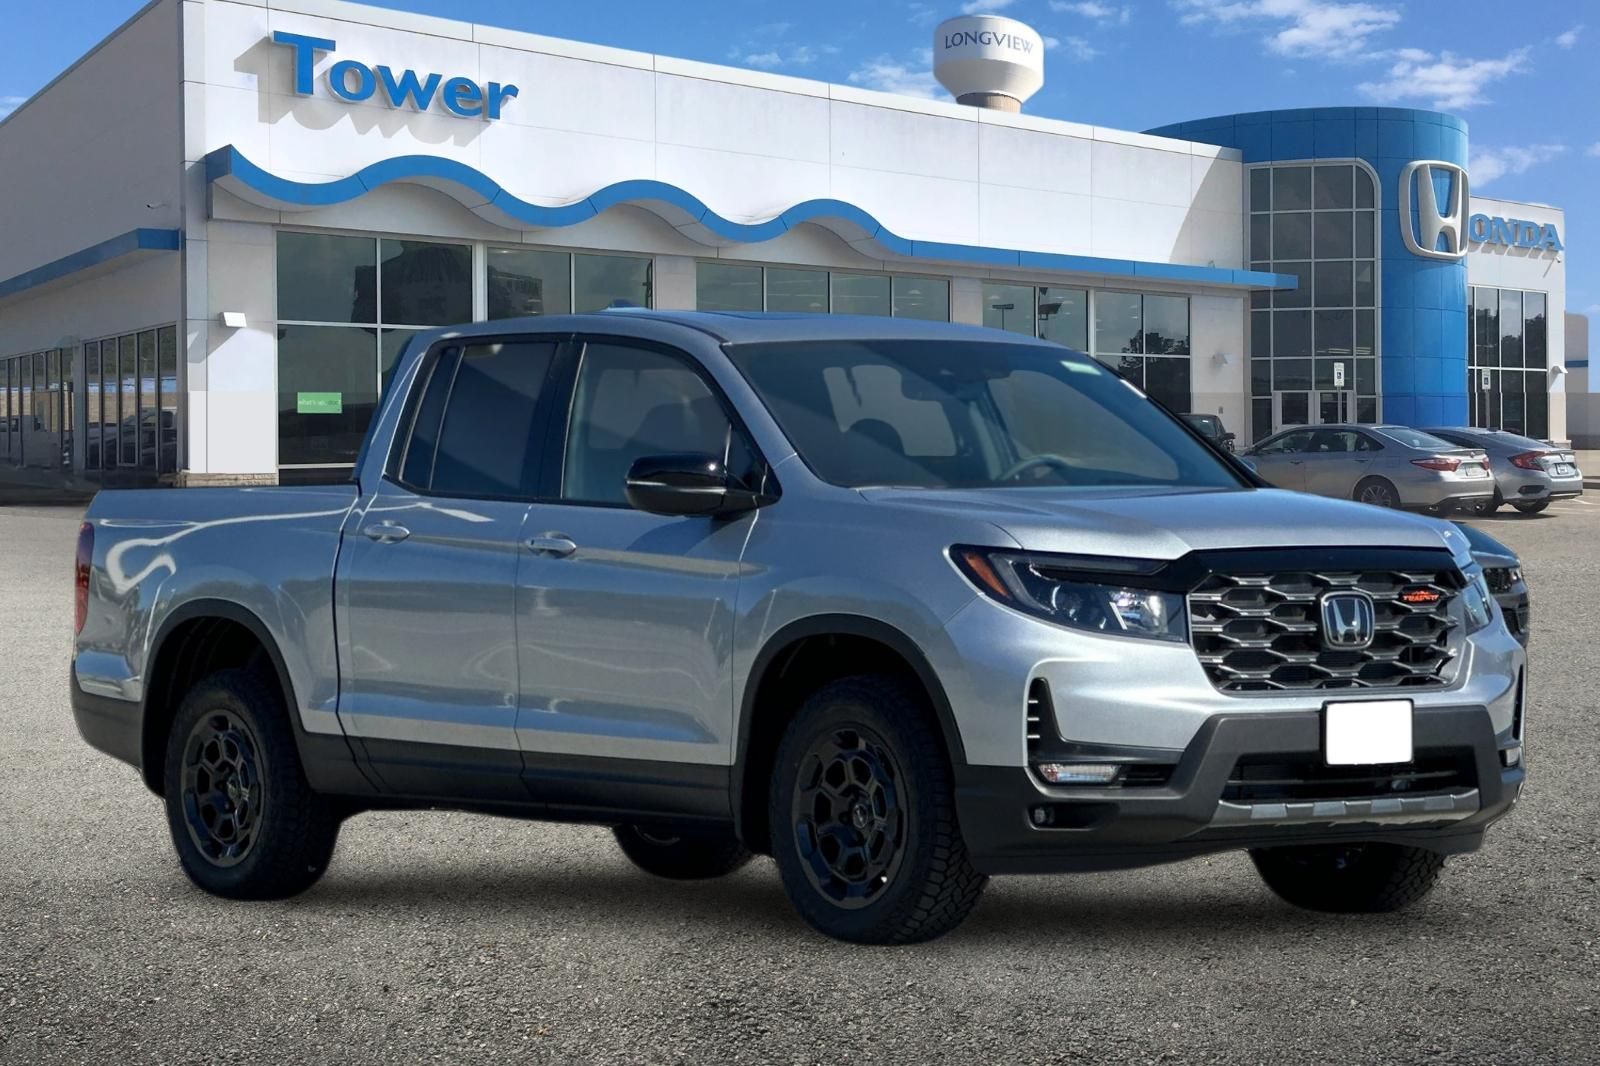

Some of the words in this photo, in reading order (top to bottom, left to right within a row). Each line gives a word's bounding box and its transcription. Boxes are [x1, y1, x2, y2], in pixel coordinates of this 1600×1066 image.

[945, 31, 1034, 55] LONGVIEW
[272, 30, 520, 120] Tower
[1469, 213, 1564, 251] ONDA
